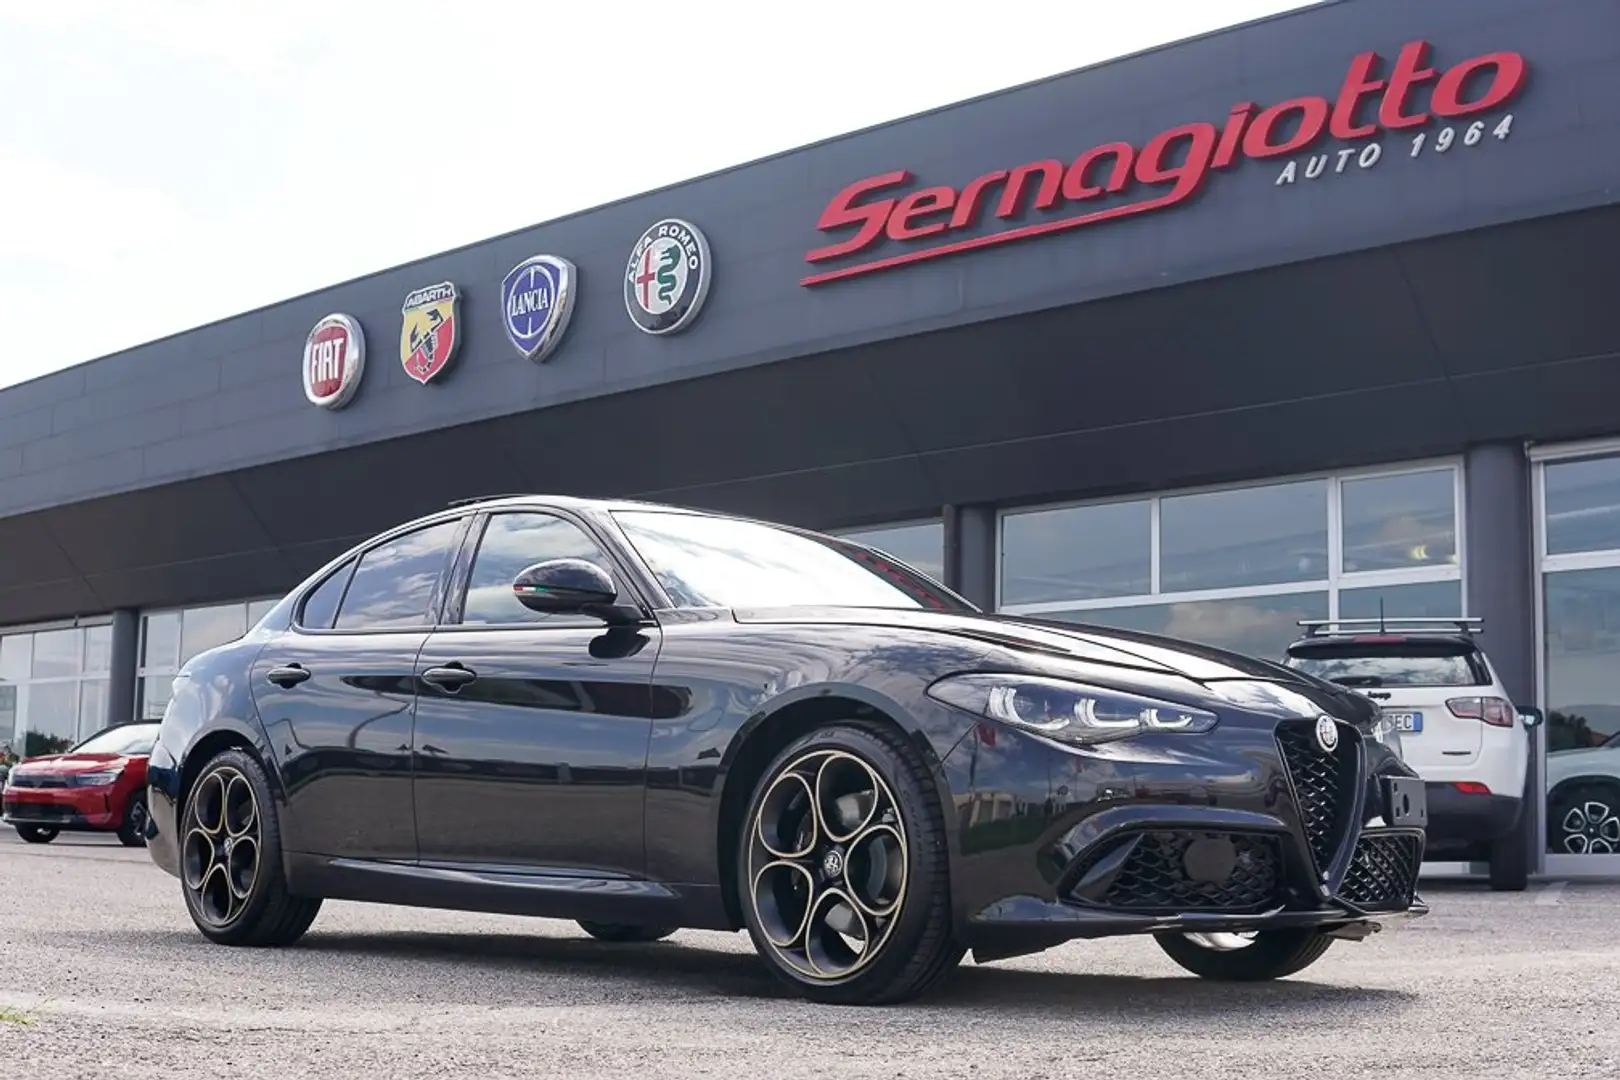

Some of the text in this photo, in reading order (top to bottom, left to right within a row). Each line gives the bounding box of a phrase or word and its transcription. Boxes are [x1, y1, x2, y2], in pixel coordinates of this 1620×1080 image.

[803, 41, 1527, 262] Sernagiotto
[1275, 114, 1513, 185] AUTO 1964
[628, 224, 699, 283] ALFA ROMEO
[407, 287, 454, 308] ABARTH
[511, 287, 549, 316] LANCIA
[311, 337, 345, 384] FIAT
